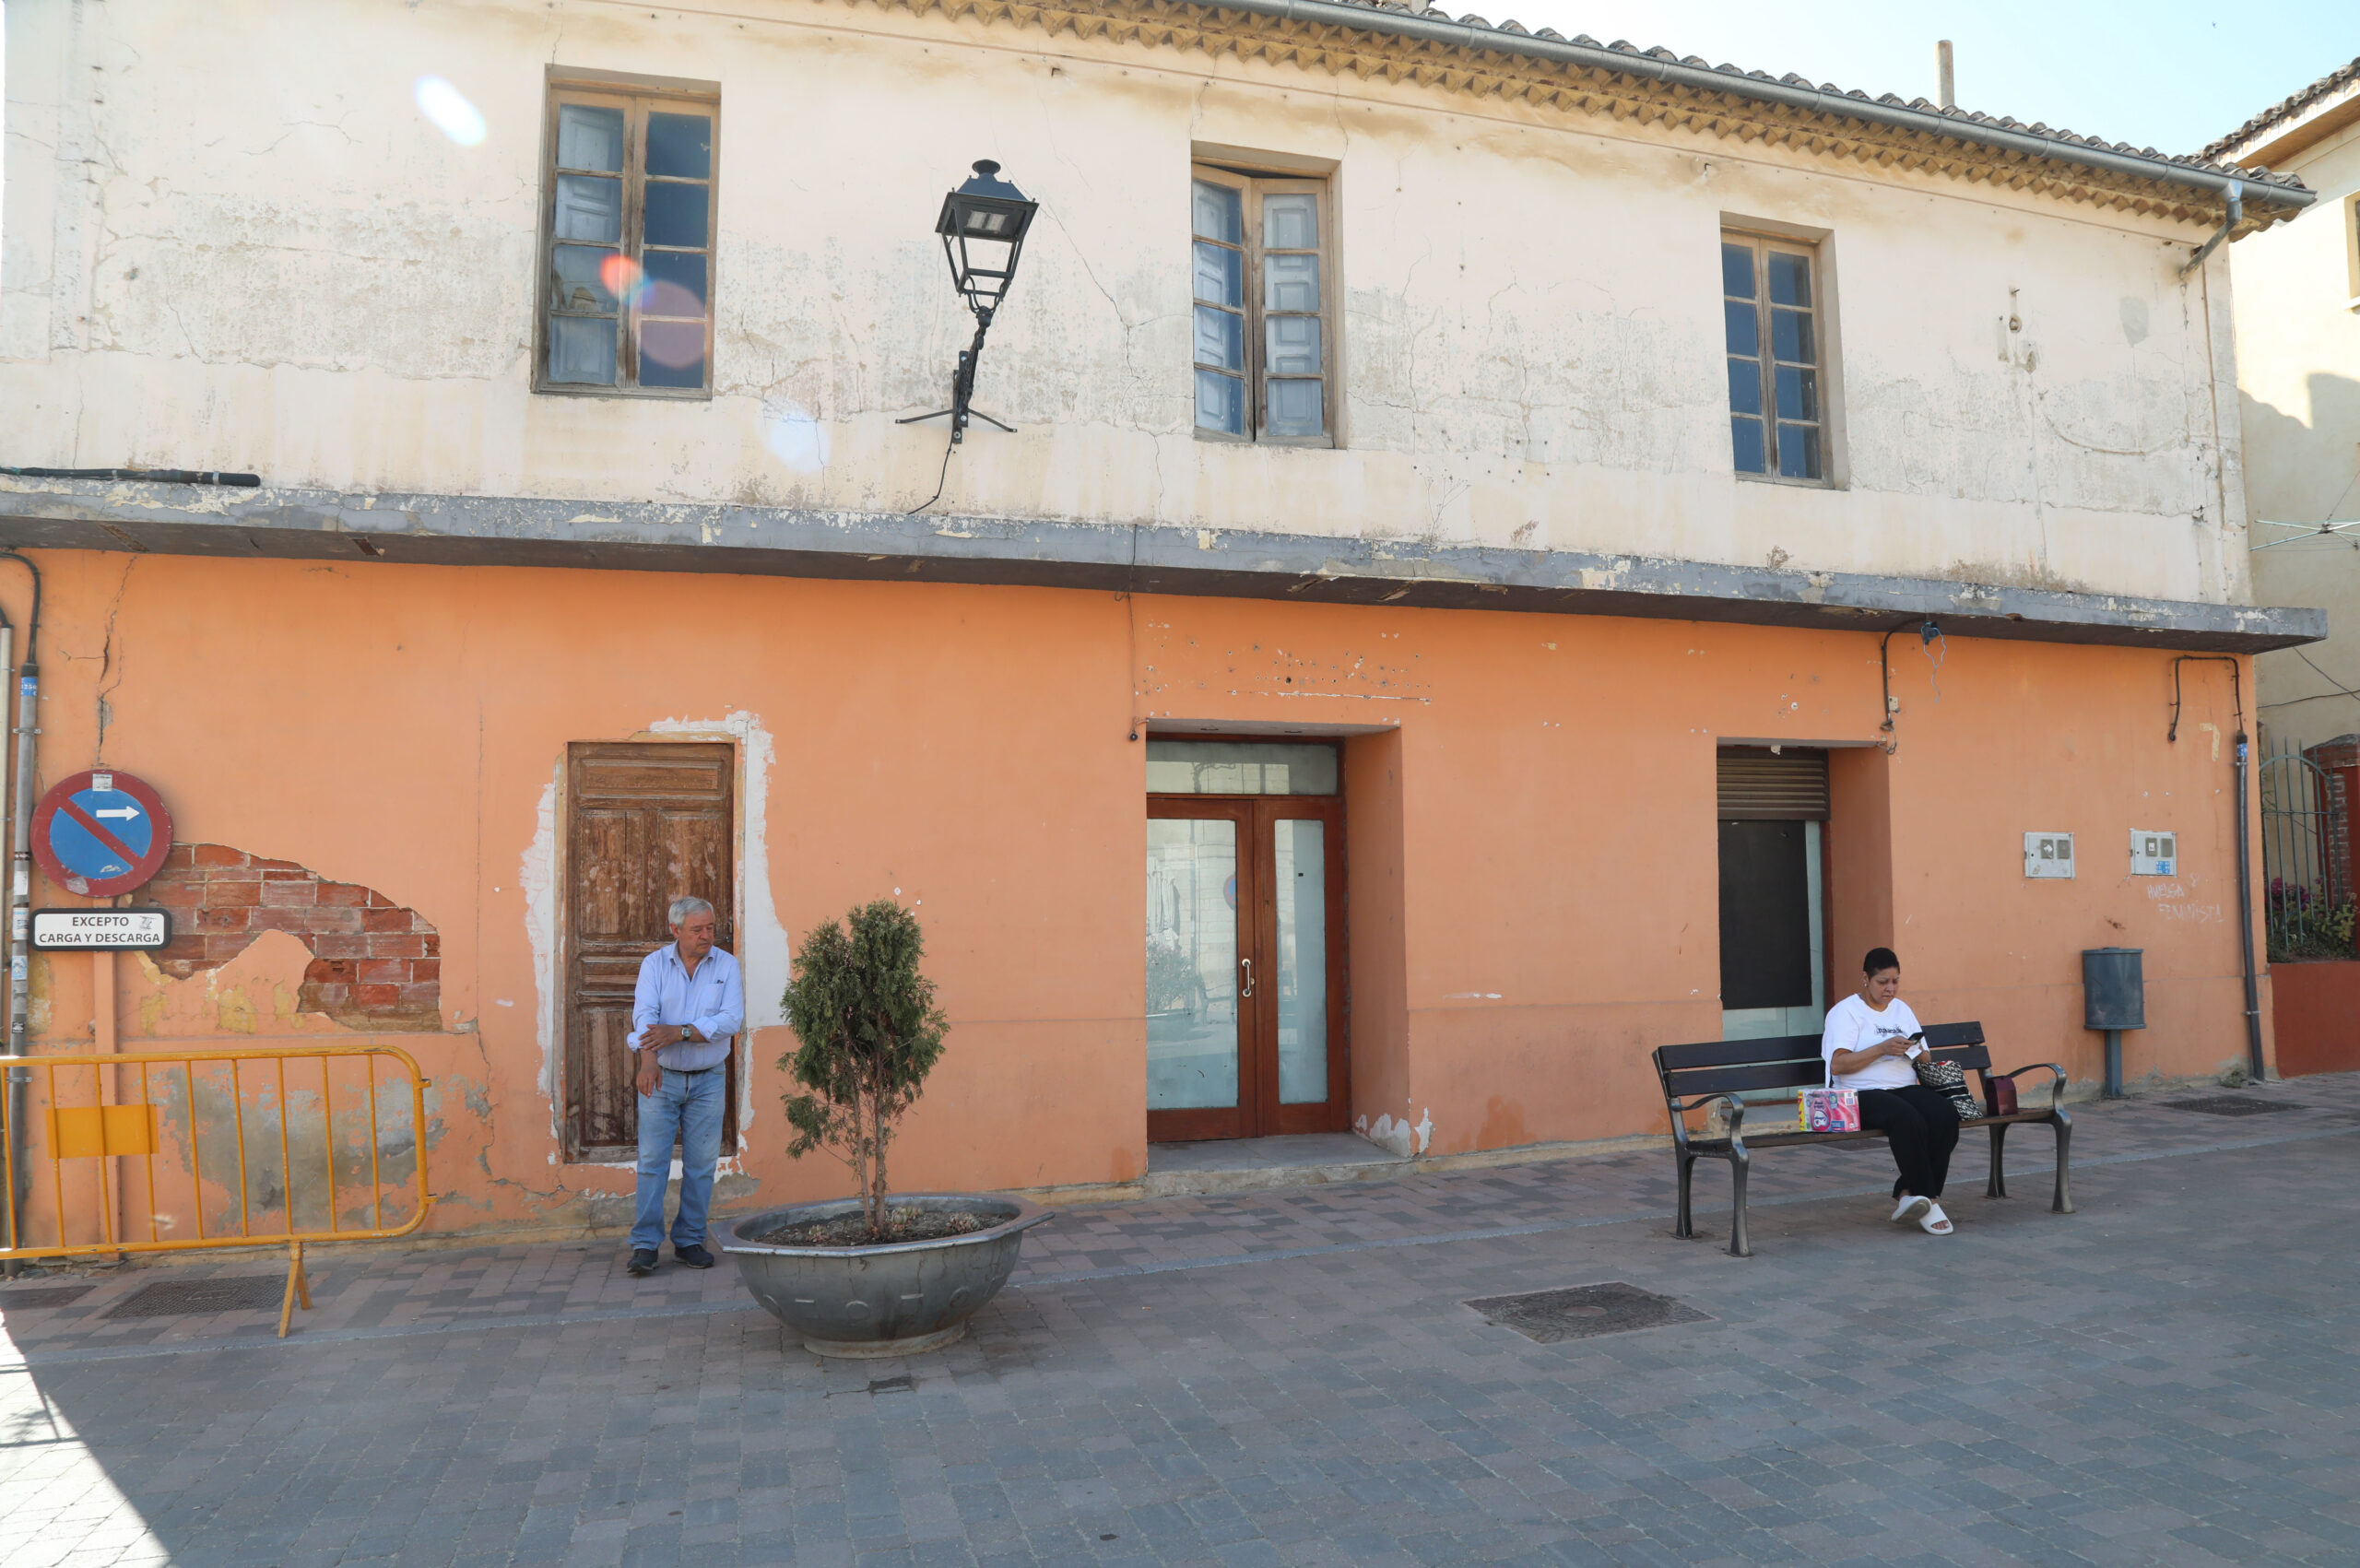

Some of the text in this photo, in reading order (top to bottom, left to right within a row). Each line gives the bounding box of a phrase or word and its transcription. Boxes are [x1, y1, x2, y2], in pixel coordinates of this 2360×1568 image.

[72, 916, 129, 926] EXCEPTO
[39, 933, 160, 943] CARGA Y DESCARGA
